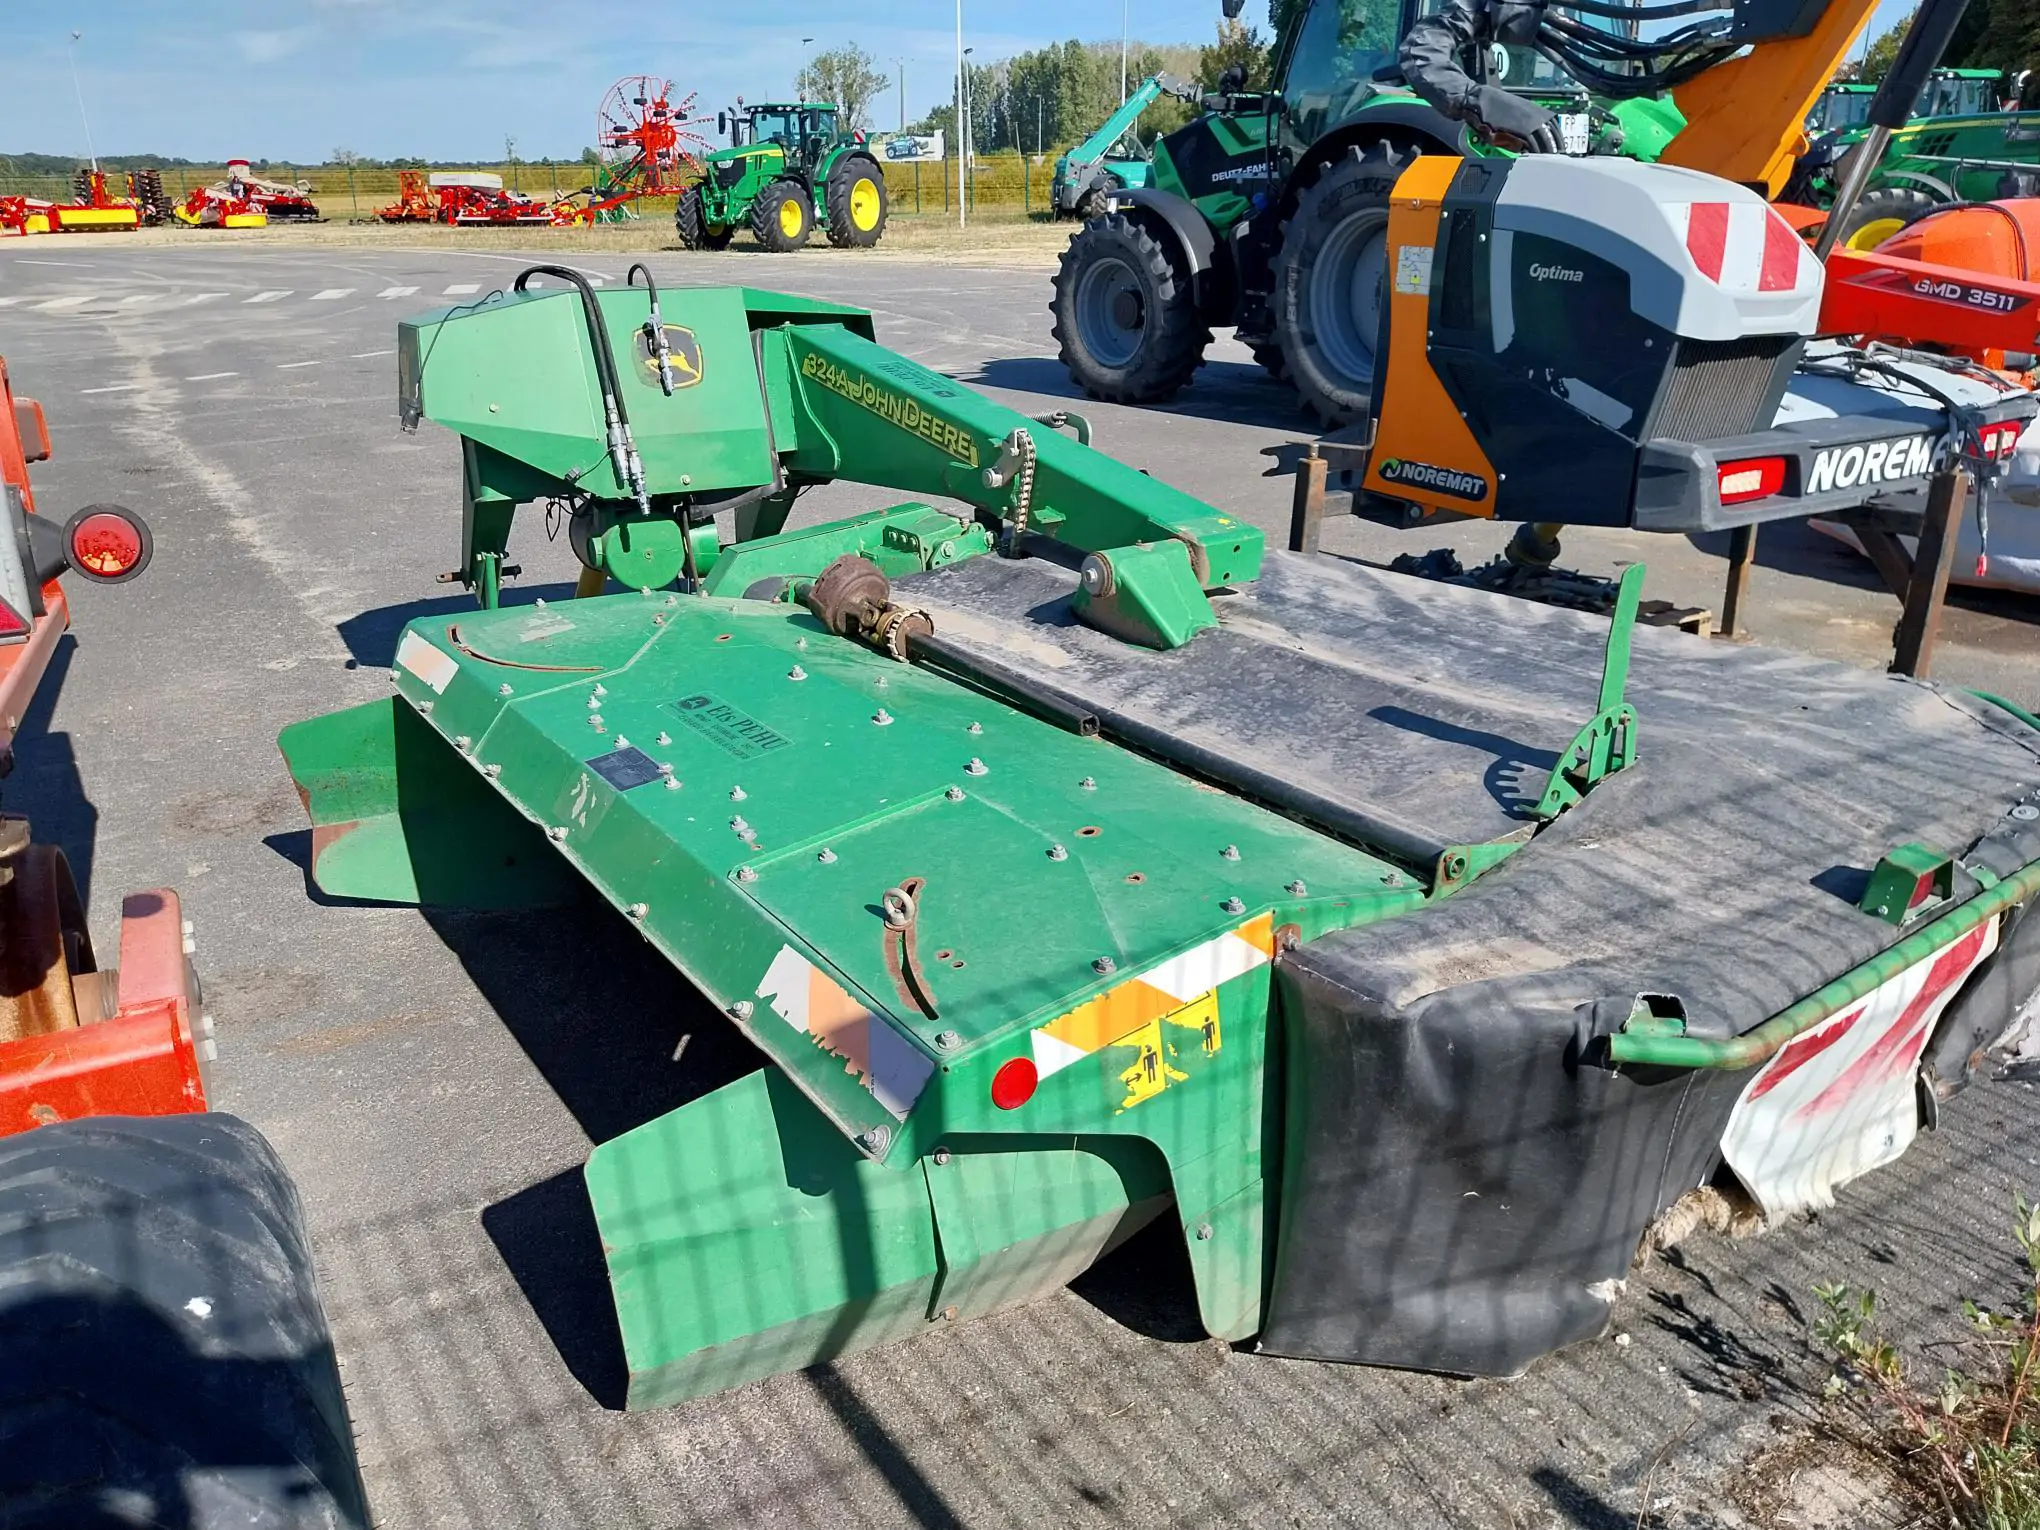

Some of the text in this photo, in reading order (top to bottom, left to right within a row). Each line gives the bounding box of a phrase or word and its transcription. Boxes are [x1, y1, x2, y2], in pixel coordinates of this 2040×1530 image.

[1529, 263, 1584, 282] Optima
[1914, 279, 2015, 311] GMD 3511
[1401, 463, 1485, 495] NOREMAT
[729, 718, 789, 751] PEHU
